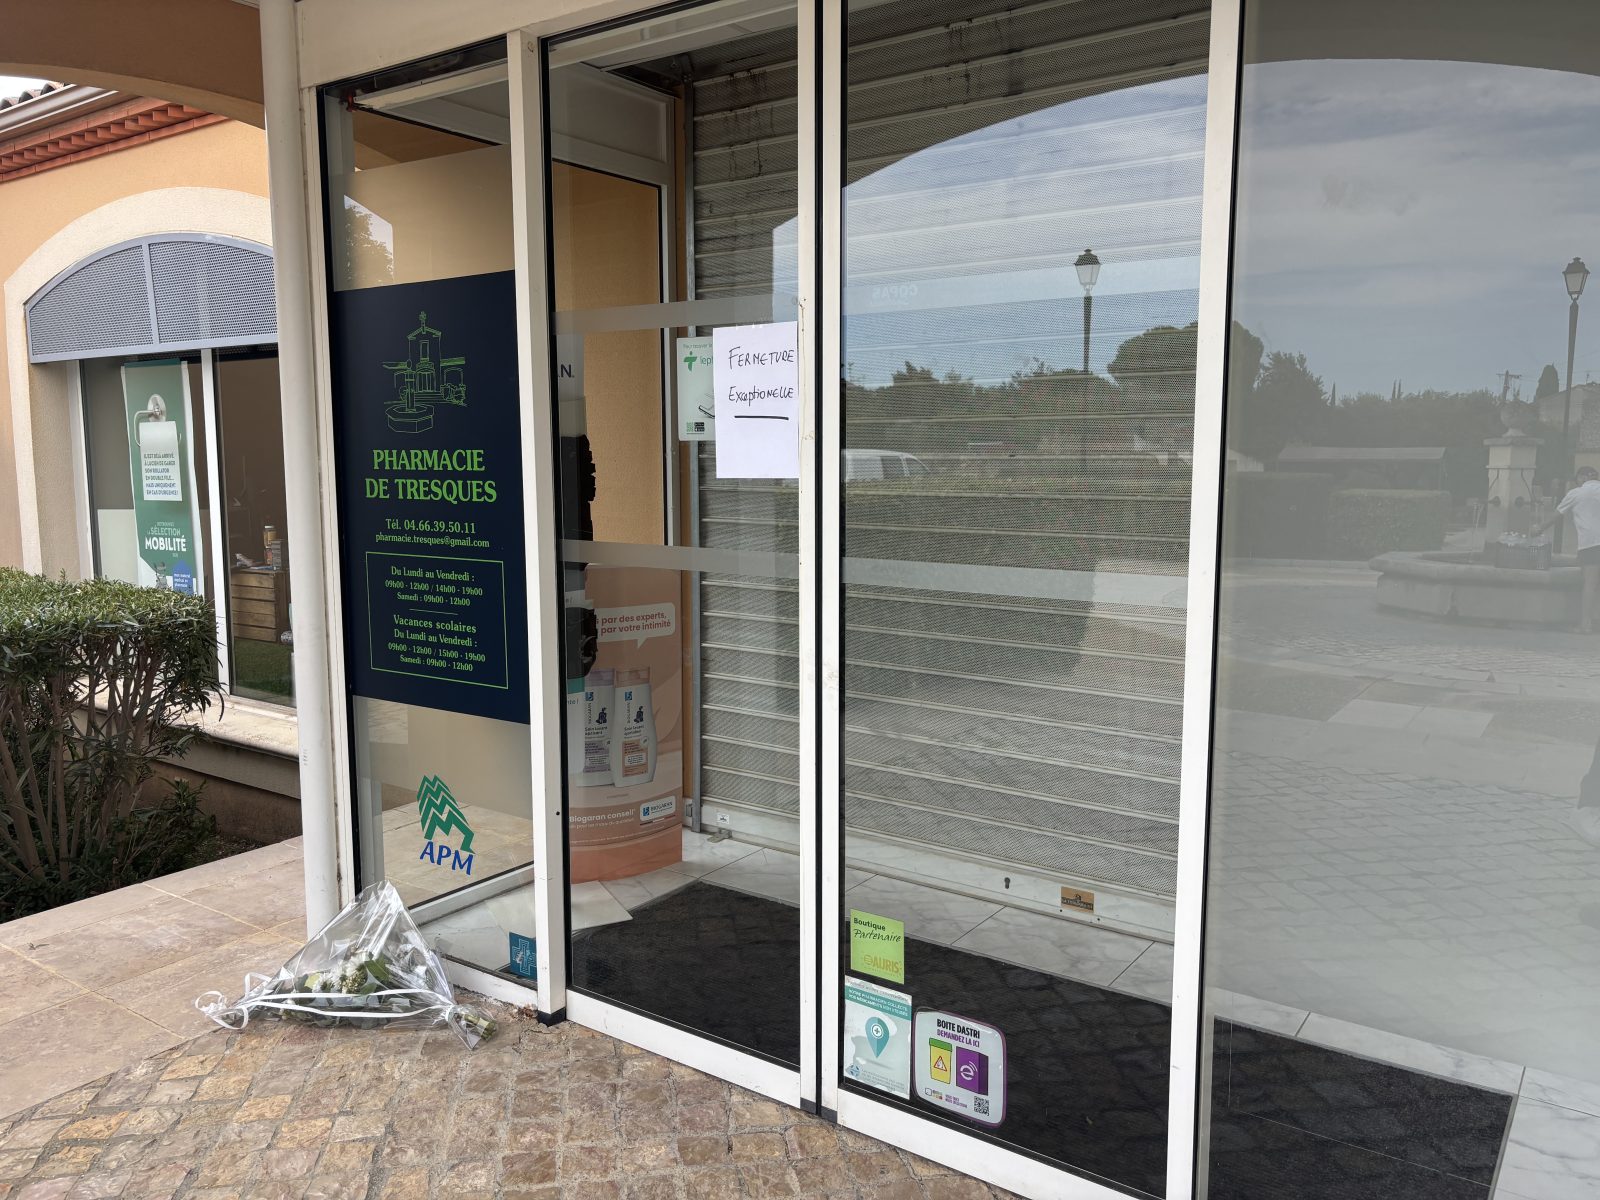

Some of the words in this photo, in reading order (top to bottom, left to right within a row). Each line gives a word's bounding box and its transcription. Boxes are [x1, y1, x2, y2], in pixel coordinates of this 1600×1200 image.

[729, 346, 794, 369] FERMETURE
[372, 449, 485, 471] PHARMACIE
[365, 478, 390, 499] DE
[395, 479, 497, 504] TRESQUES
[150, 525, 180, 536] SÉLECTION
[403, 519, 476, 534] 04.66.39.50.11
[145, 535, 186, 552] MOBILITÉ
[375, 532, 490, 548] pharmacie.tresques@gmail.com
[391, 566, 401, 575] Du
[403, 567, 423, 578] Lundi
[425, 571, 434, 579] au
[436, 569, 470, 581] Vendredi
[385, 579, 404, 588] 09h00
[410, 582, 429, 591] 12h00
[436, 584, 456, 593] 14h00
[462, 586, 483, 596] 19h00
[397, 592, 419, 601] Samedi
[423, 595, 444, 604] 09h00
[450, 597, 470, 606] 12h00
[393, 615, 433, 628] Vacances
[436, 620, 477, 634] scolaires
[601, 617, 618, 626] par
[619, 615, 635, 623] des
[636, 612, 667, 623] experts,
[601, 627, 618, 636] par
[642, 619, 671, 630] intimité
[394, 629, 404, 638] Du
[406, 629, 426, 642] Lundi
[439, 634, 473, 647] Vendredi
[388, 642, 407, 652] 09h00
[413, 646, 432, 654] 12h00
[438, 649, 459, 658] 15h00
[465, 652, 486, 662] 19h00
[400, 654, 422, 665] Samedi
[426, 659, 447, 668] 09h00
[452, 662, 473, 671] 12h00
[651, 801, 673, 812] BIOGARAN
[569, 813, 606, 823] Biogaran
[419, 841, 474, 876] APM
[854, 918, 885, 931] Boutique
[854, 928, 901, 942] Partenaire
[937, 1019, 955, 1032] BOITE
[957, 1024, 980, 1039] DASTRI
[937, 1029, 965, 1043] DEMANDEZ
[972, 1039, 980, 1048] ICI
